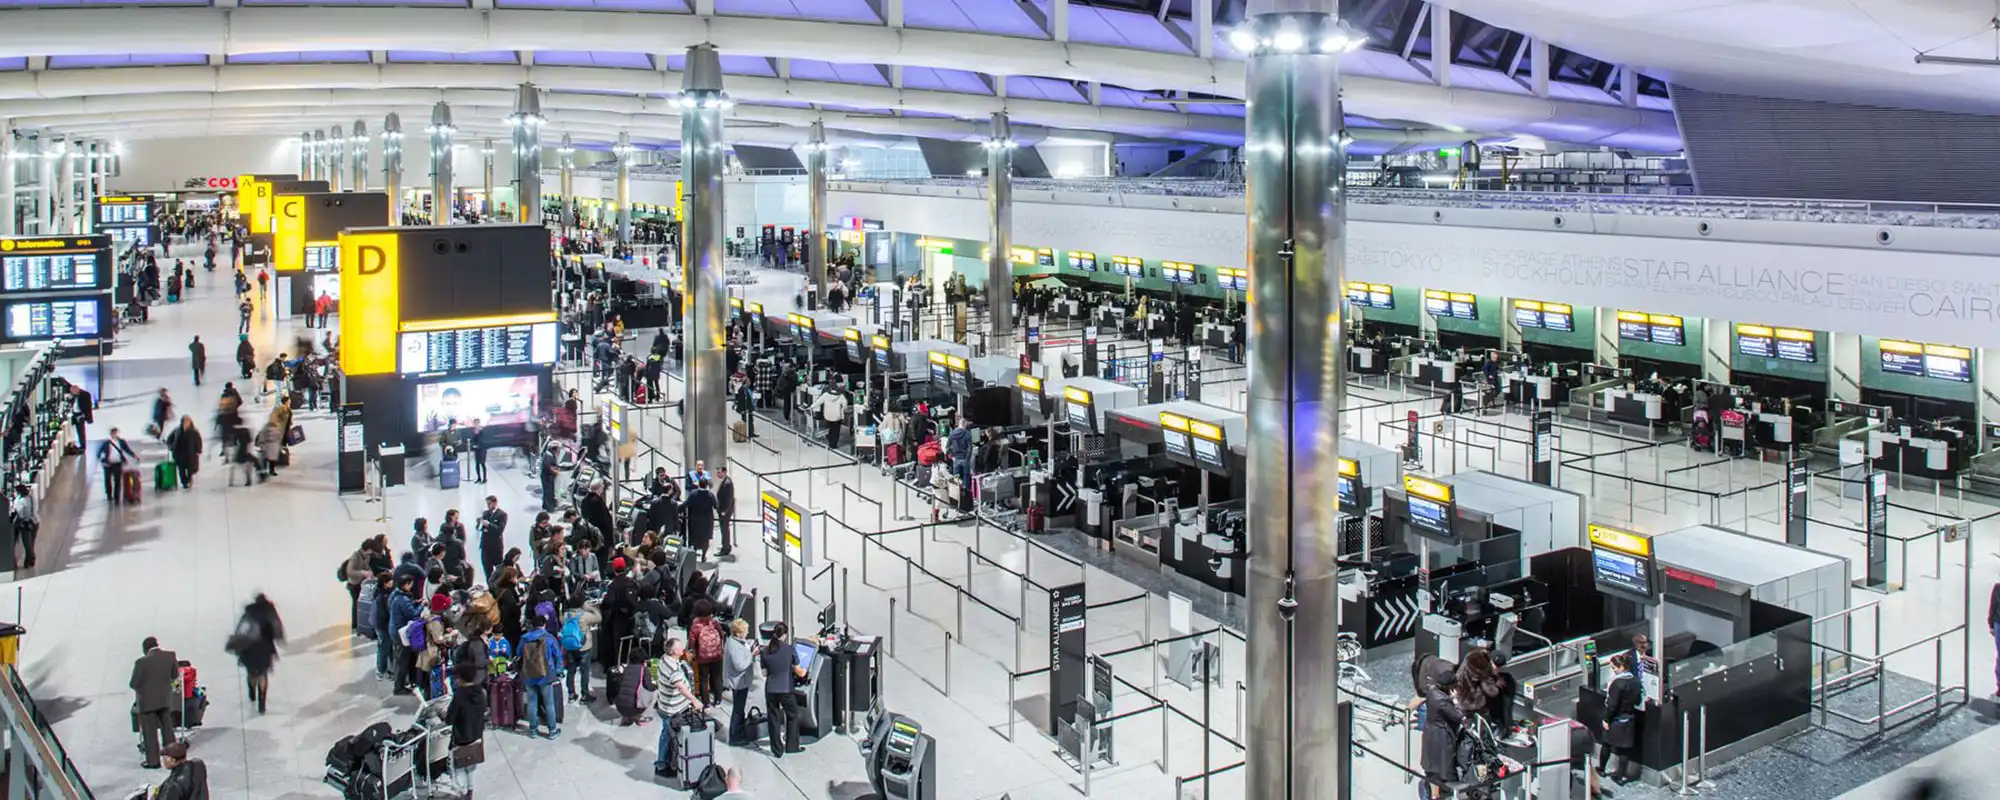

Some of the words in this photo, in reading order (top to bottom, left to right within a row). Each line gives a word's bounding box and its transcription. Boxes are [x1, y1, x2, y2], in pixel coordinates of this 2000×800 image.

[242, 179, 252, 188] A
[257, 187, 266, 198] B
[284, 201, 298, 218] C
[17, 240, 65, 249] Information
[357, 245, 386, 275] D
[1380, 250, 1443, 272] TOKYO
[1561, 253, 1622, 271] ATHENS
[1482, 261, 1603, 286] STOCKHOLM
[1624, 258, 1690, 282] STAR
[1698, 263, 1846, 295] ALLIANCE
[1848, 273, 1883, 289] SAN
[1887, 276, 1946, 294] DIEGO
[1723, 287, 1779, 303] CUSCO
[1838, 297, 1905, 314] DENVER
[1908, 292, 2000, 322] CAIR
[1052, 601, 1060, 645] ALLIANCE
[1052, 647, 1060, 671] STAR
